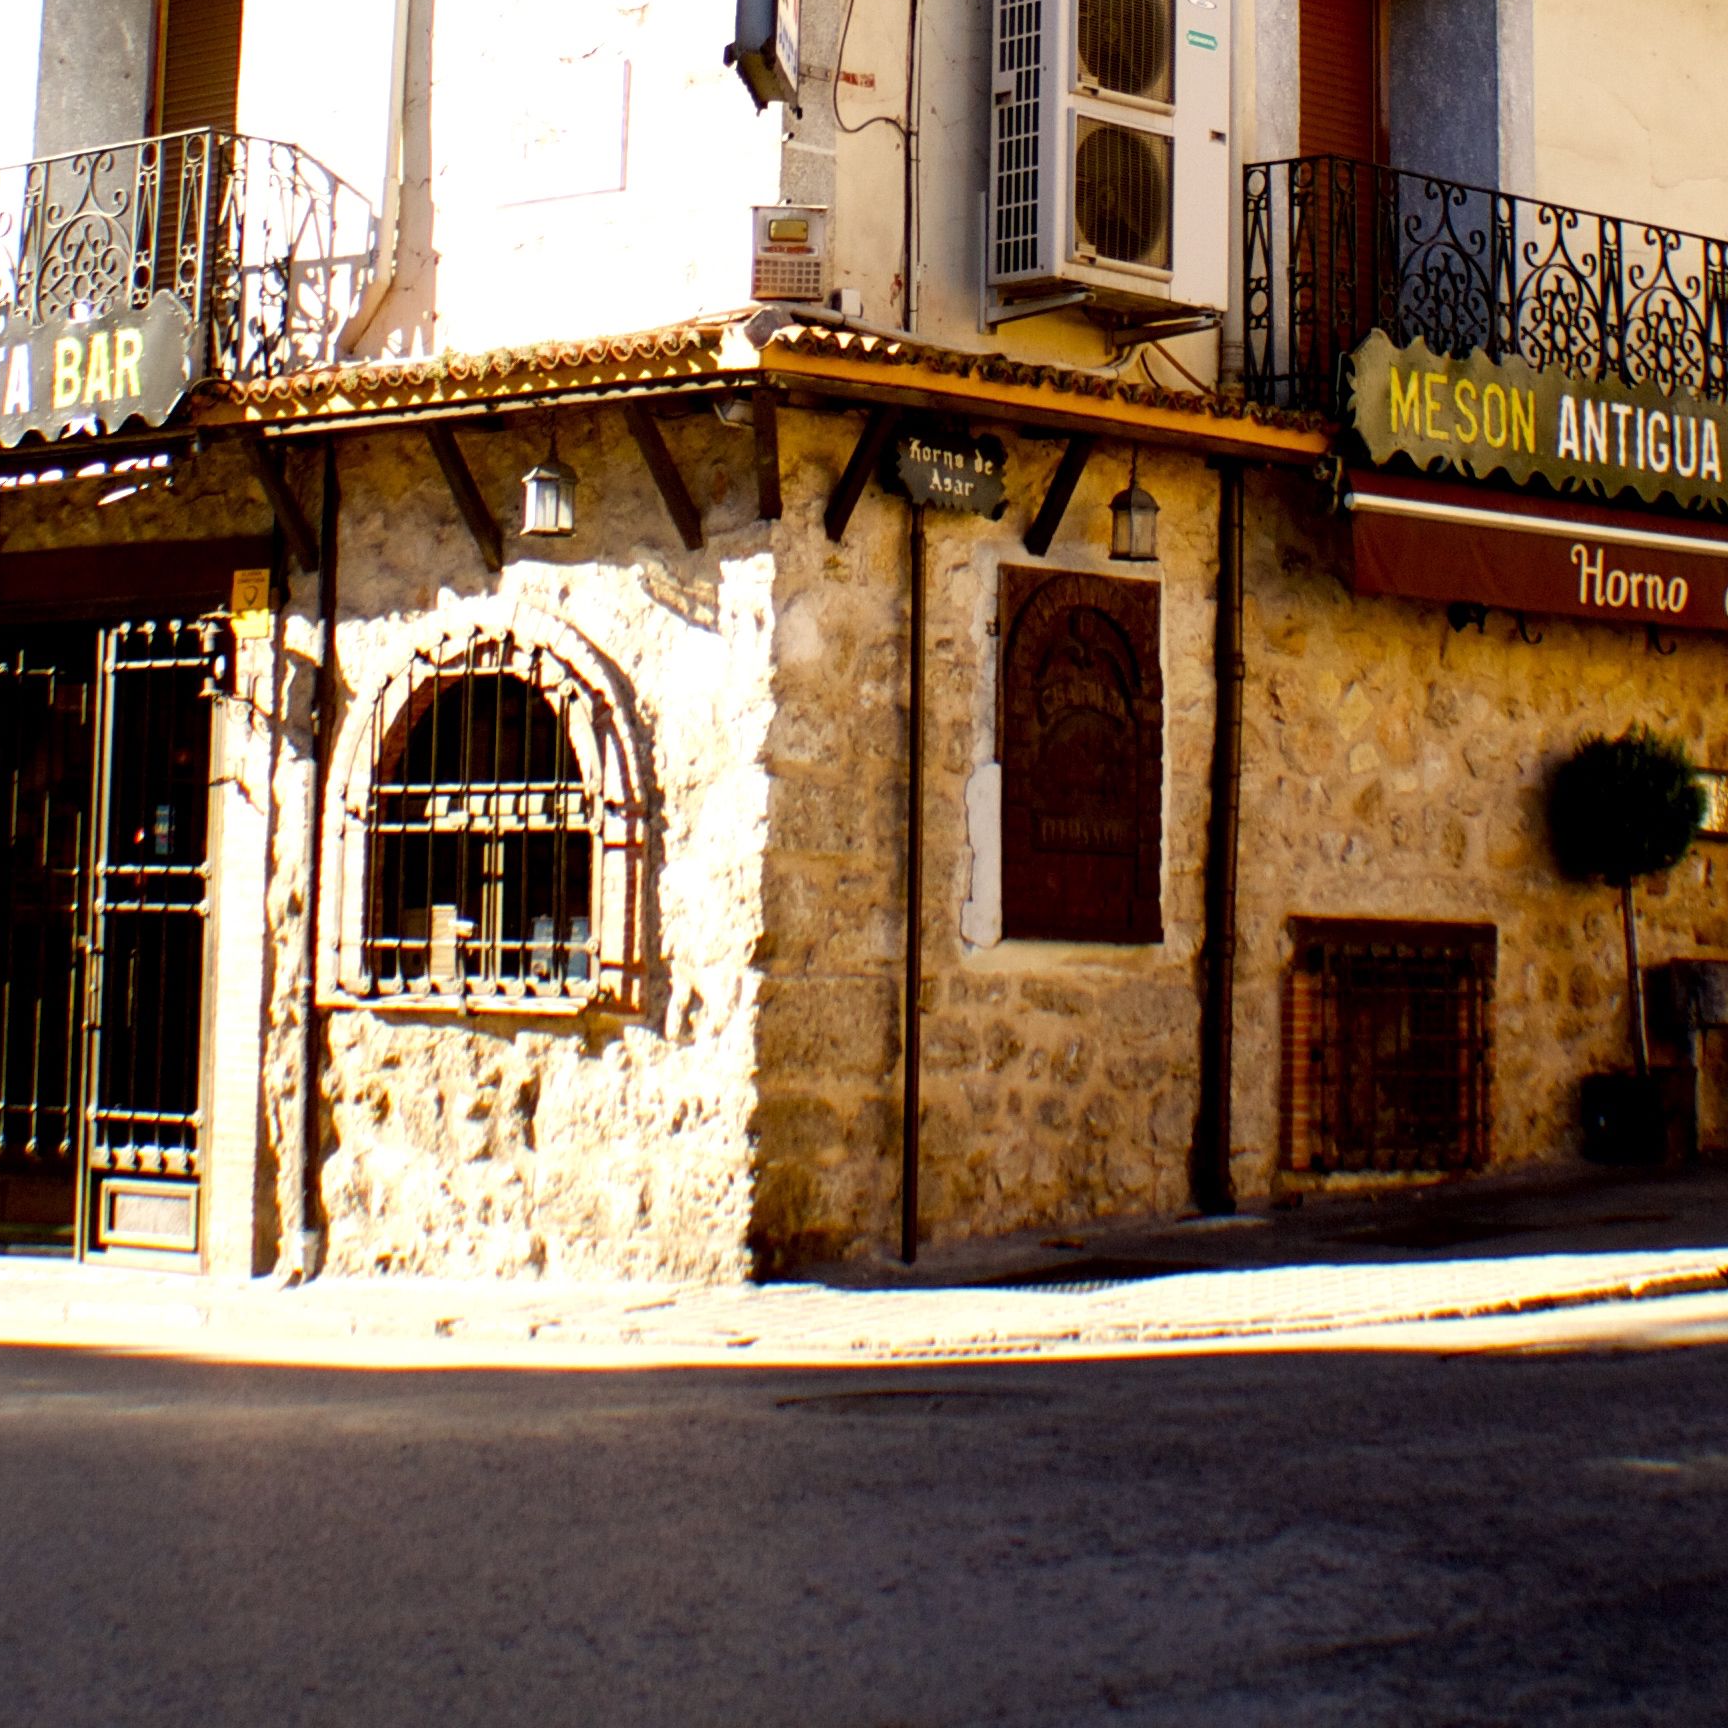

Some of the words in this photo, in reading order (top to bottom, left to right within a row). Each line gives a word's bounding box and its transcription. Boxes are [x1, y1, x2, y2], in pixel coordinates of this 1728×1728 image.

[52, 327, 144, 410] BAR
[974, 448, 993, 475] de
[1389, 366, 1537, 455] MESON
[1558, 394, 1723, 484] ANTIGUA
[1571, 543, 1689, 614] Horno
